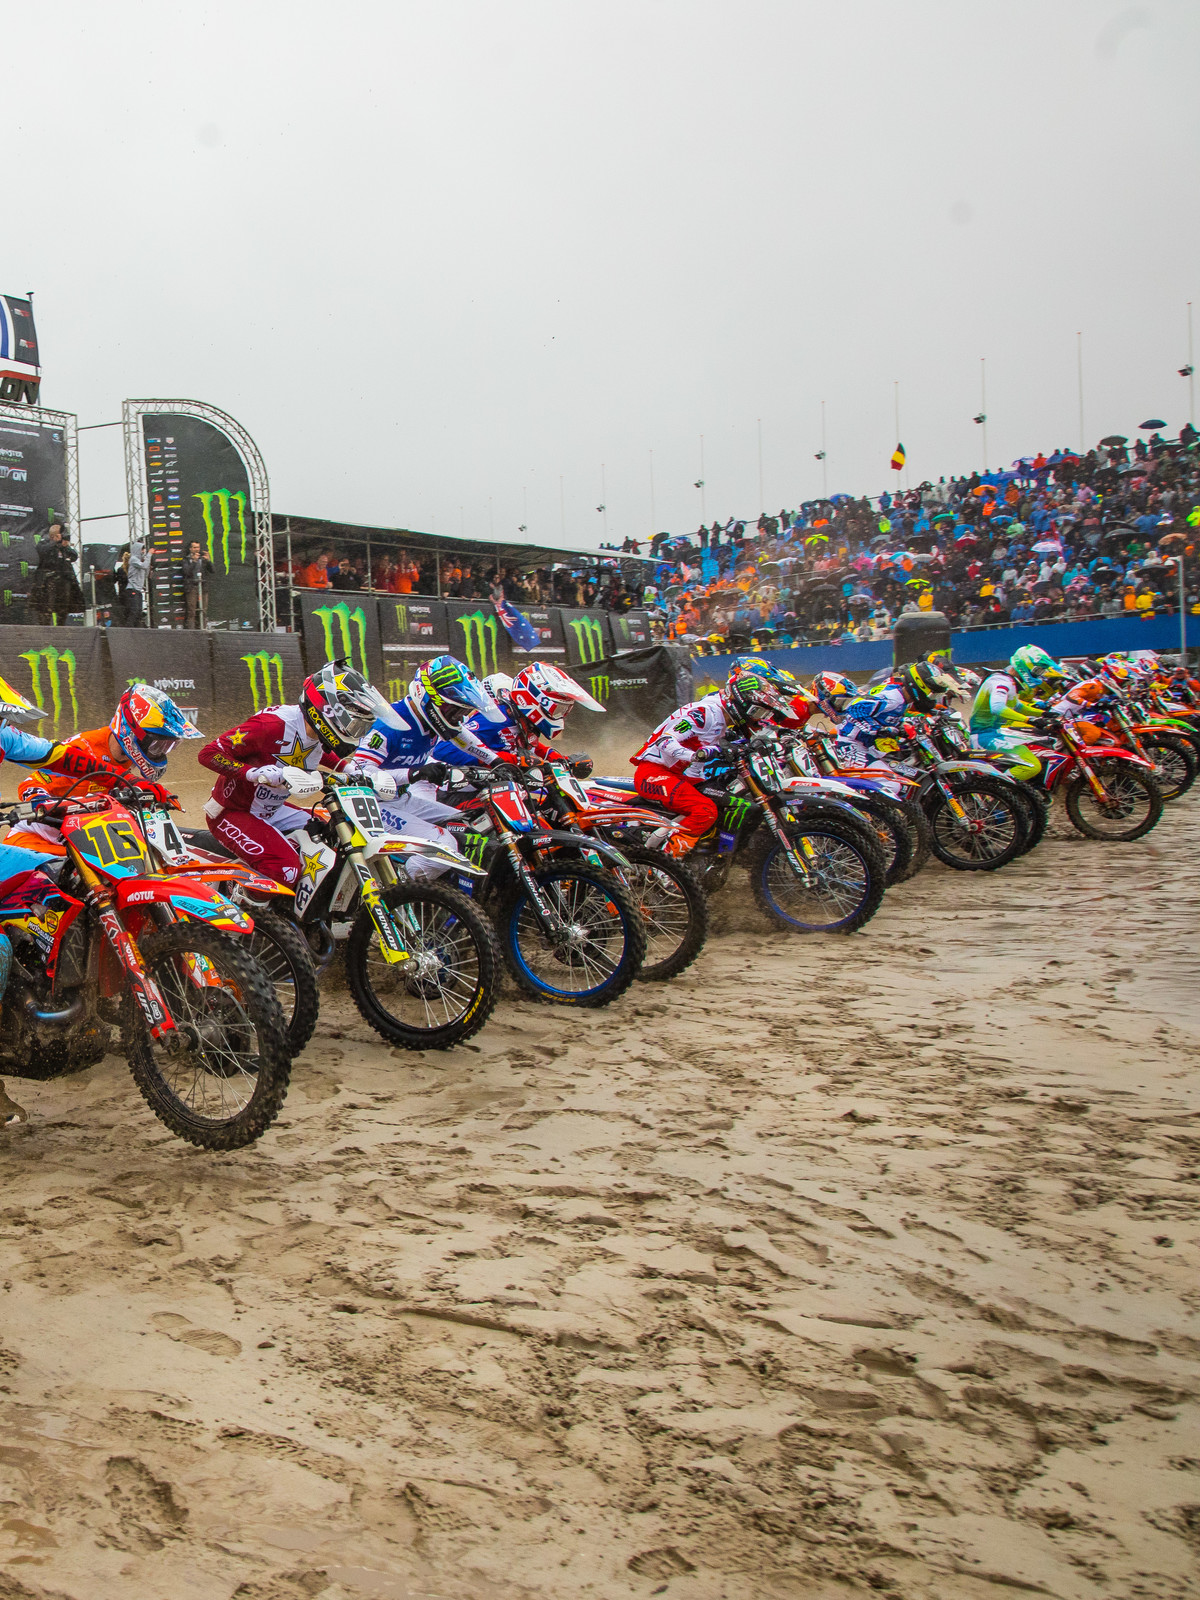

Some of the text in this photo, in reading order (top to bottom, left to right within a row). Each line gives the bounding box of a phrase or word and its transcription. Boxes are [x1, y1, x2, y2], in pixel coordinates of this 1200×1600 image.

[154, 678, 195, 690] MONSTER
[308, 706, 340, 747] ROCKSTAR
[352, 798, 384, 829] 99
[510, 792, 525, 817] 1
[83, 820, 144, 867] 16
[163, 823, 183, 854] 4
[127, 891, 155, 902] MOTUL
[375, 907, 398, 951] DUNLOP
[137, 991, 154, 1024] UFO
